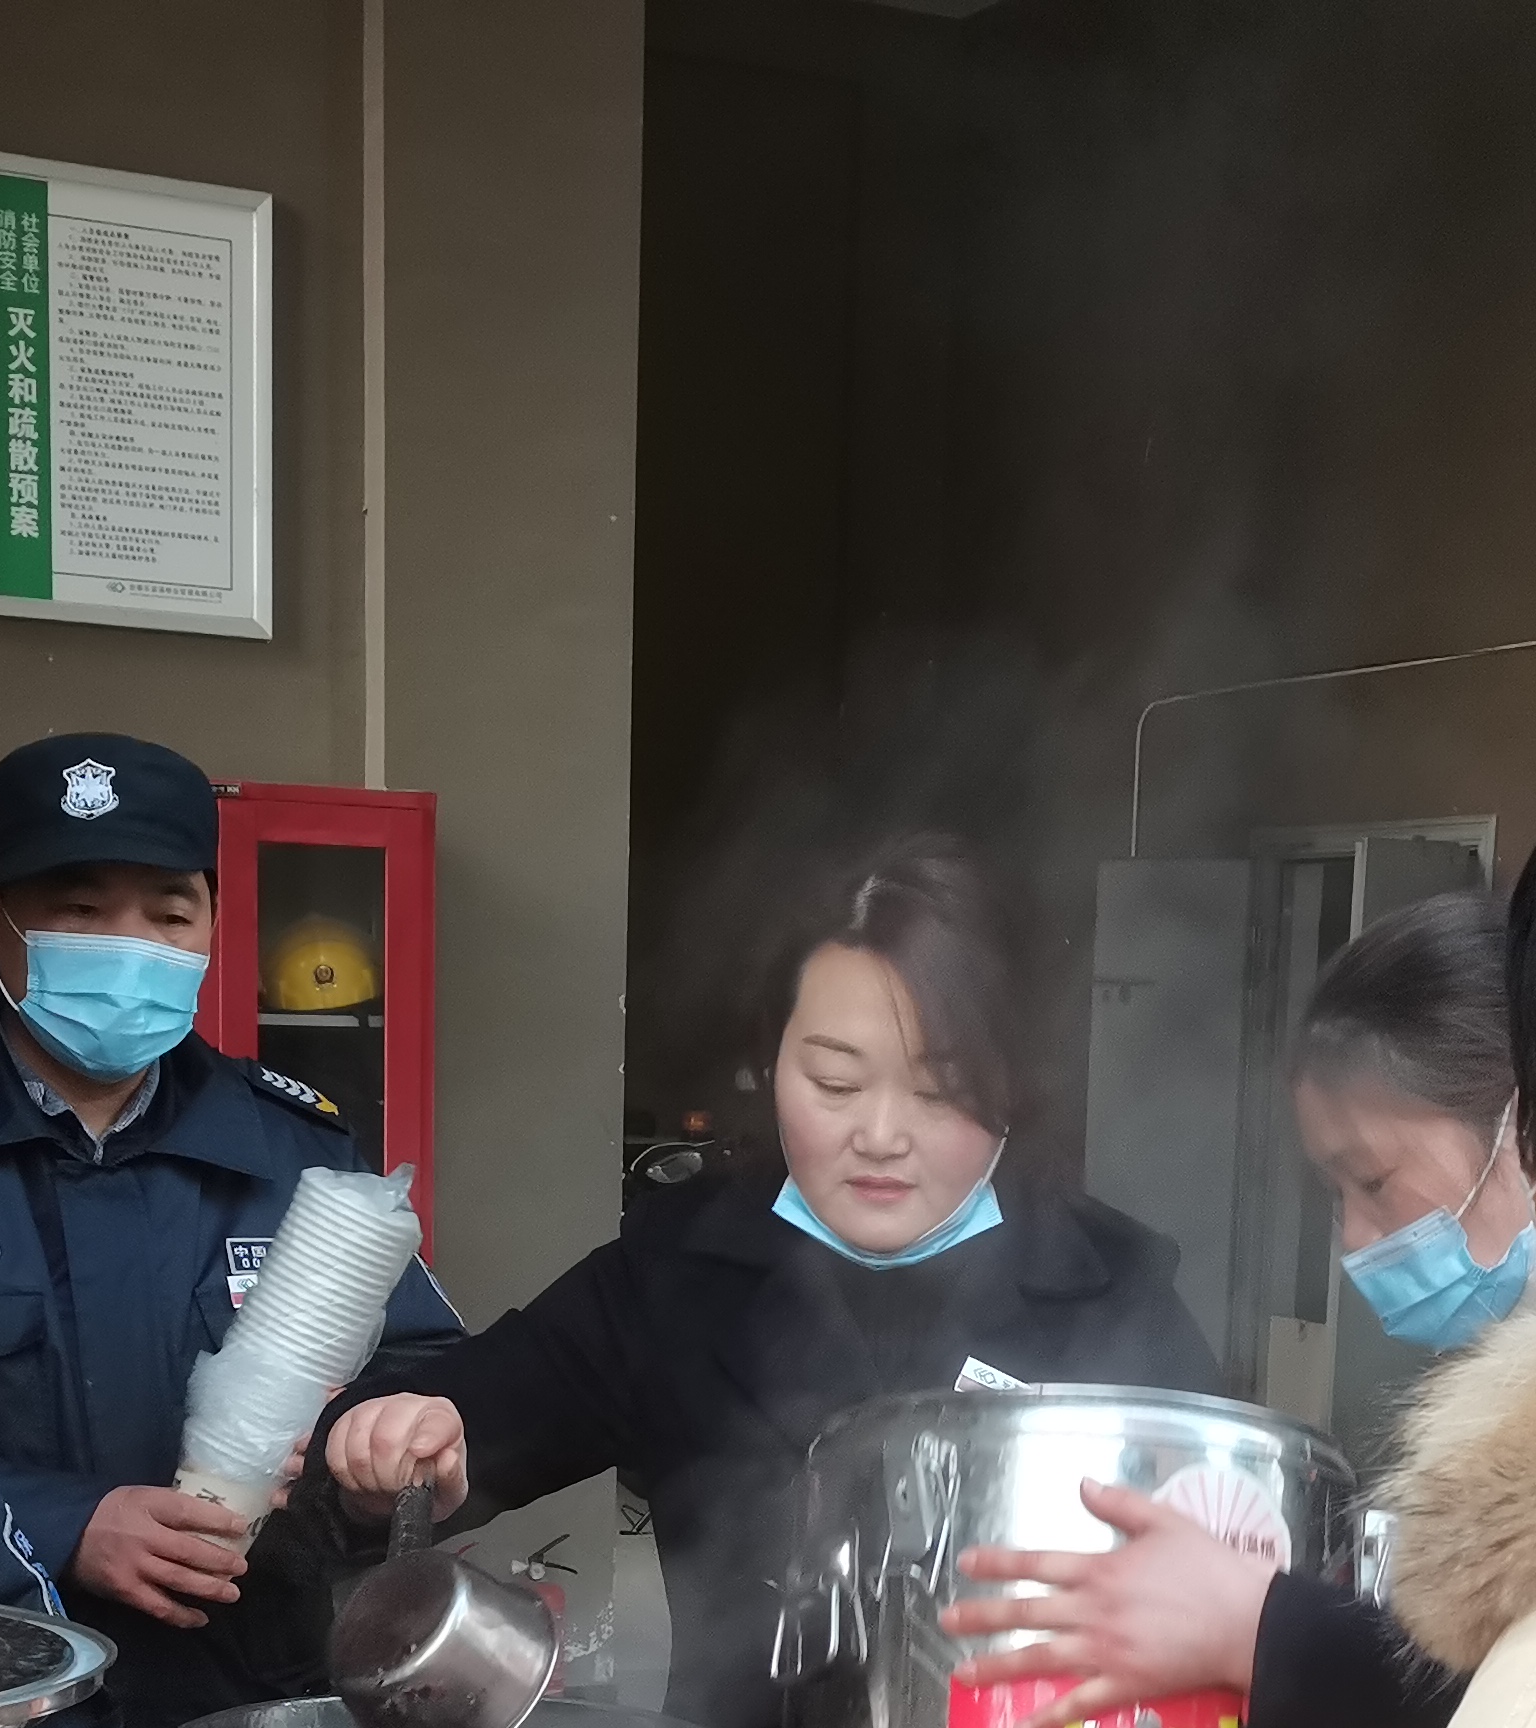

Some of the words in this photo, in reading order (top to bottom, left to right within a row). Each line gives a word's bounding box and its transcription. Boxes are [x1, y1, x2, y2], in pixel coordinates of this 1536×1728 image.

[21, 211, 41, 295] 社会单位
[7, 306, 40, 539] 灭火和疏散预案
